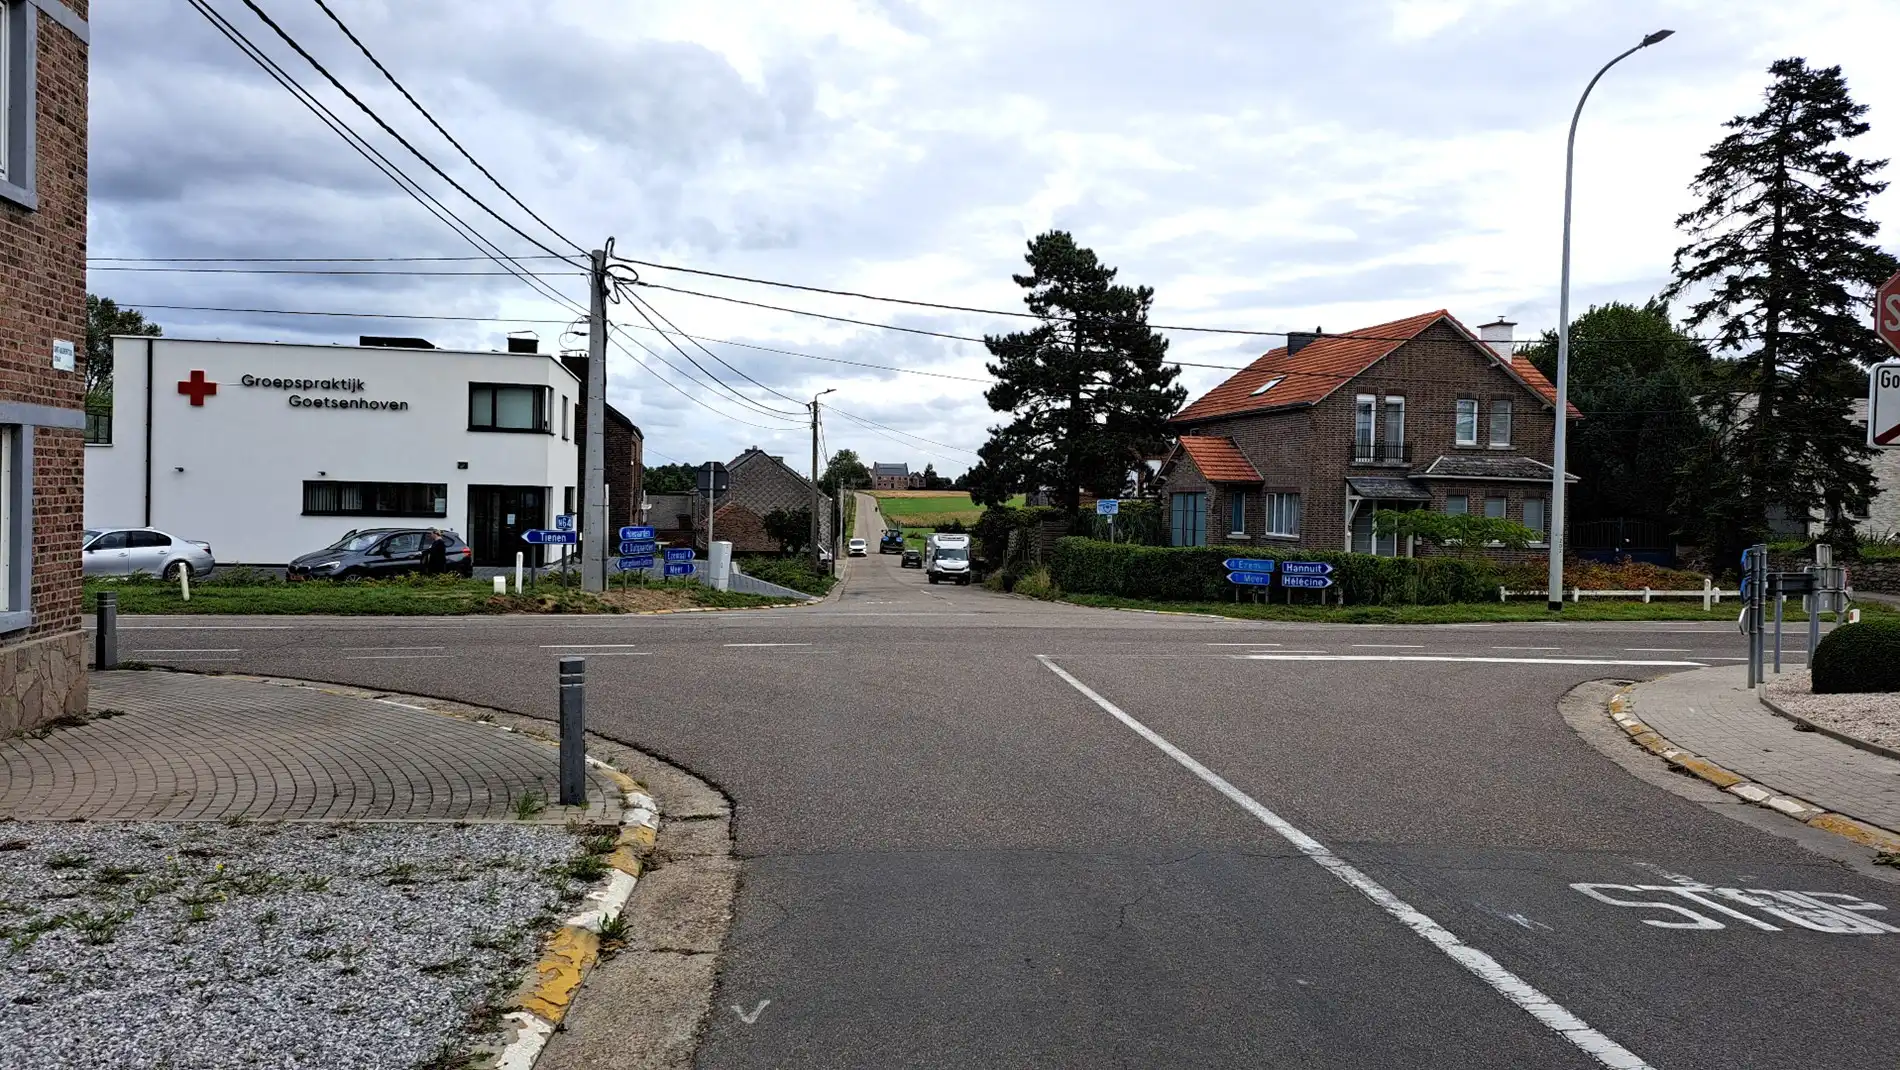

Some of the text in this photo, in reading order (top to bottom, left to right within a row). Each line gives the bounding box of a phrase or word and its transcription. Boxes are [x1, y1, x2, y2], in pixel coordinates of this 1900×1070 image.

[241, 374, 365, 393] Groepspraktijk
[288, 394, 408, 411] Goetsenhoven
[558, 517, 572, 528] N64
[540, 532, 567, 542] Tienen
[669, 565, 683, 574] Meer
[1286, 563, 1322, 573] Hannuit
[1243, 574, 1264, 583] Meer
